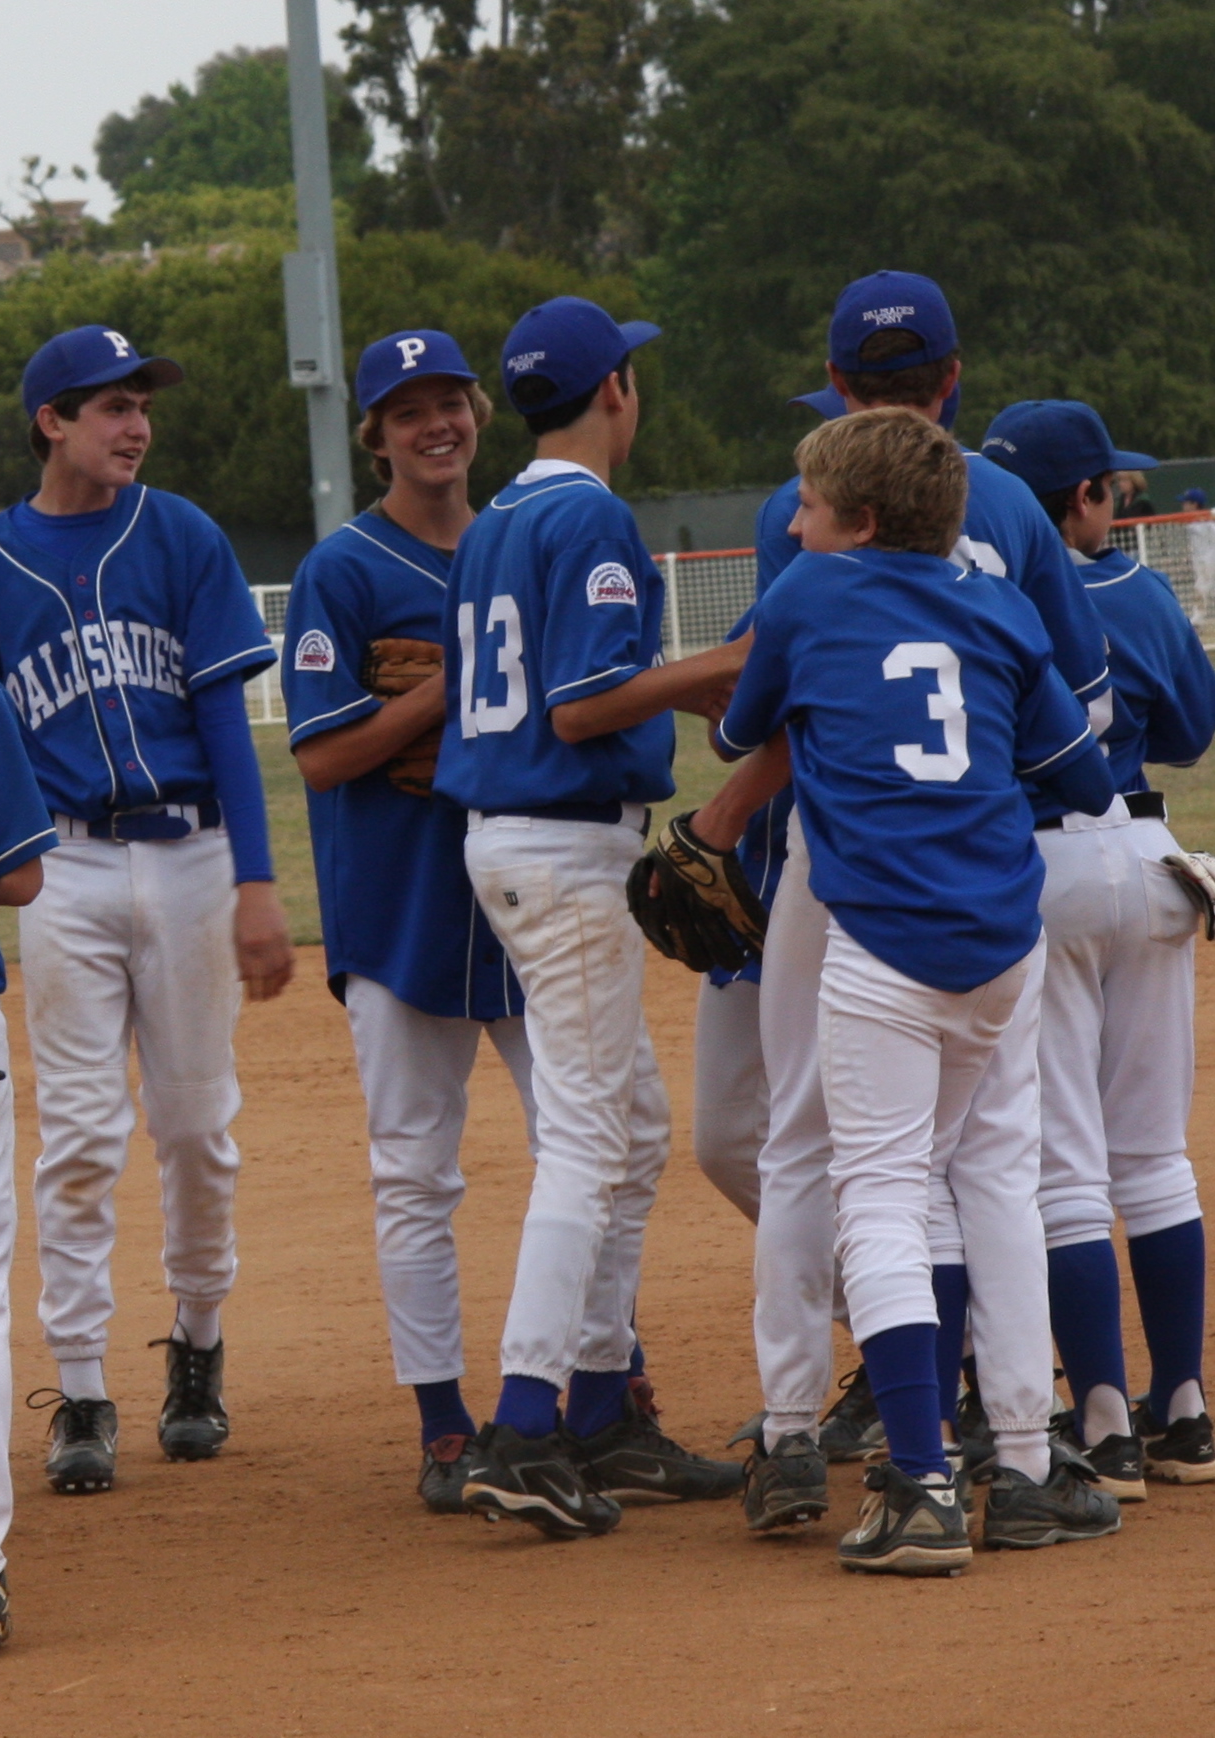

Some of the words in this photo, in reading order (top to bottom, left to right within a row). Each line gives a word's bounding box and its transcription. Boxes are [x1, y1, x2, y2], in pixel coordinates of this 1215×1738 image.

[862, 305, 915, 321] PALISADES
[875, 314, 903, 326] PONY
[103, 331, 129, 358] P
[396, 337, 426, 370] P
[5, 620, 188, 731] PALISADES
[457, 594, 528, 739] 13
[882, 641, 972, 783] 3
